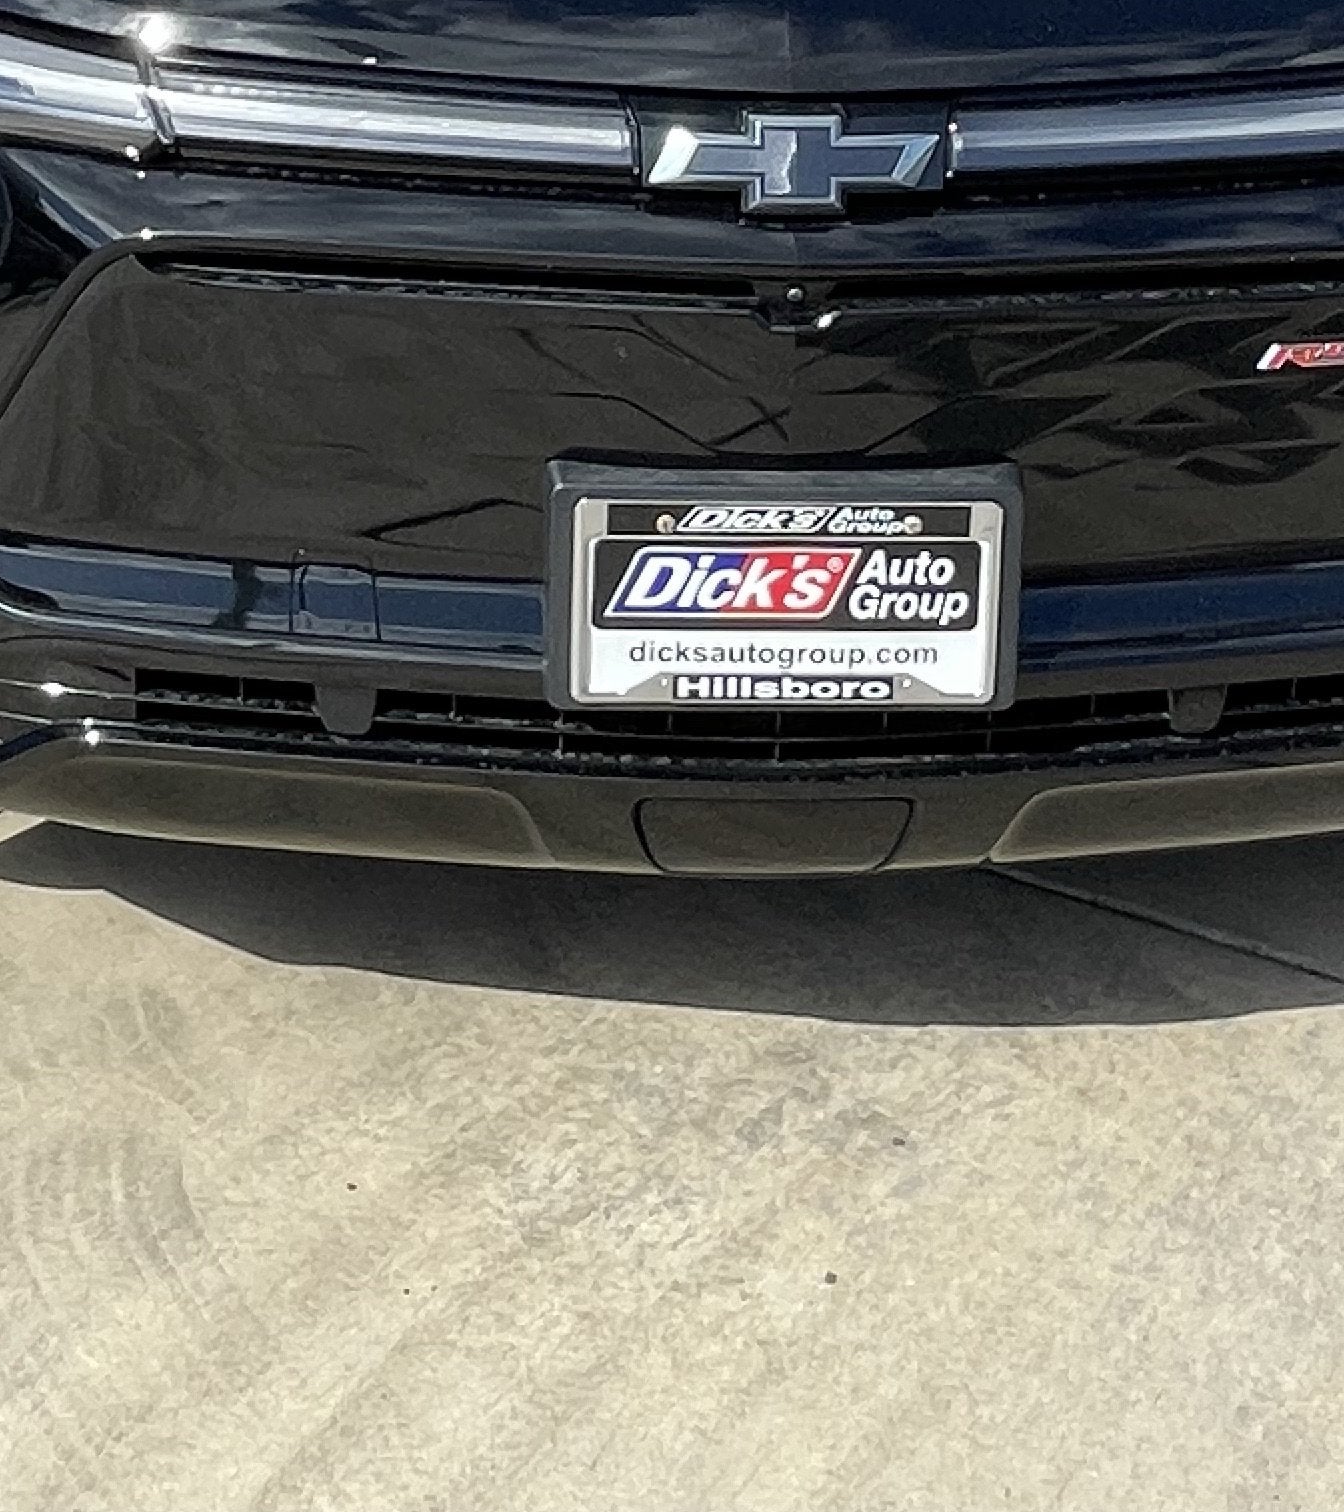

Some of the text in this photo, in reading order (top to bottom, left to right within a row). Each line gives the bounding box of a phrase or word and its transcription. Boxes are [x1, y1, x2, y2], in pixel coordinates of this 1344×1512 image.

[833, 506, 895, 521] Auto
[827, 520, 905, 535] Group
[855, 548, 956, 586] Auto
[848, 585, 969, 626] Group
[628, 640, 939, 669] dicksautogroup.com
[676, 676, 892, 699] Hillsboro
